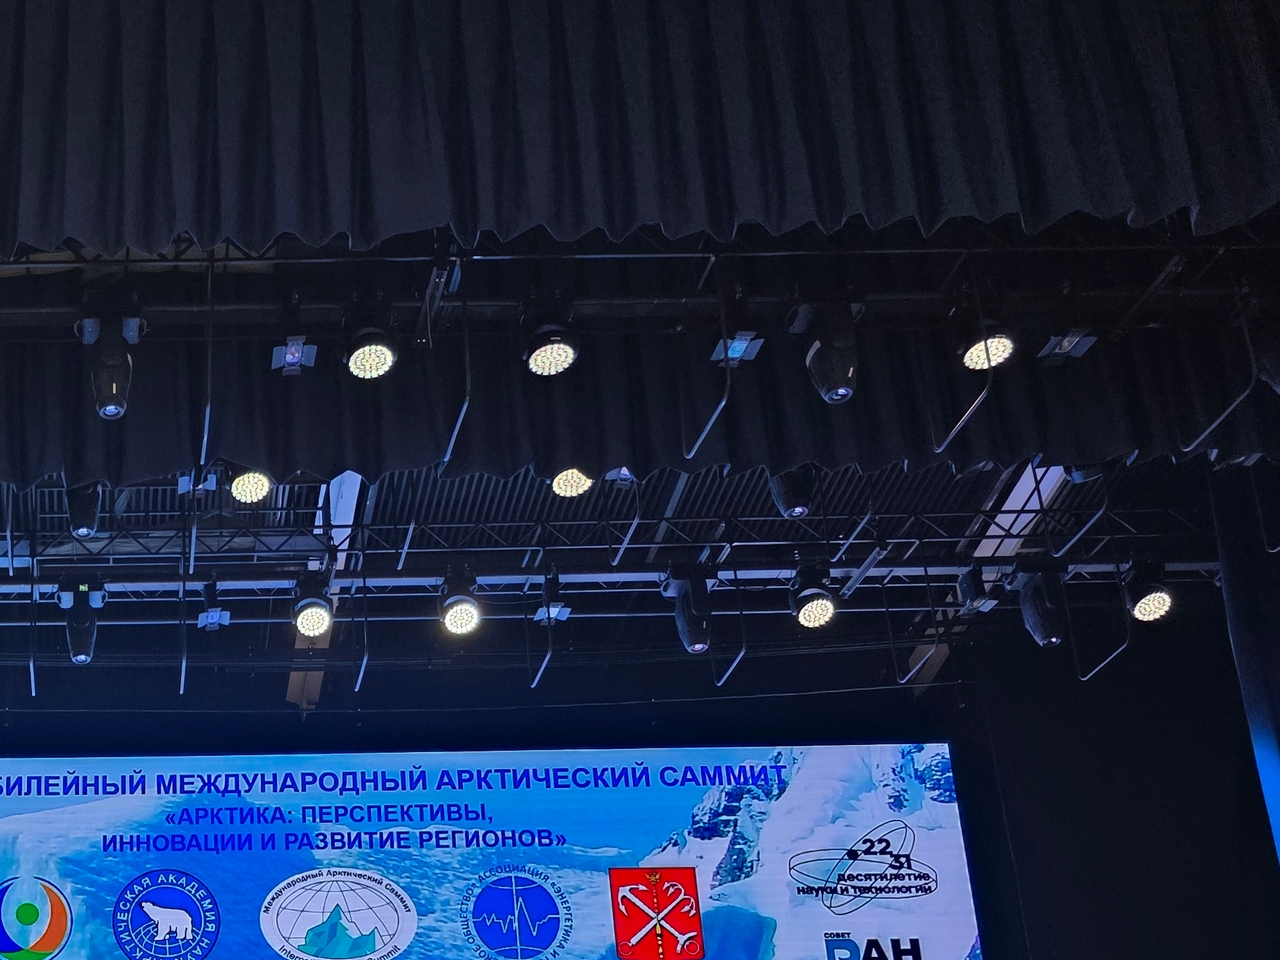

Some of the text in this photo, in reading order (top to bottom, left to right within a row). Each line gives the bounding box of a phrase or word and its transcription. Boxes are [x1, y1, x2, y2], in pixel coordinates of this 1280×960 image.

[156, 765, 428, 797] МЕЖДУНАРОДНЫЙ
[435, 762, 652, 791] АРКТИЧЕСКИЙ
[658, 764, 788, 788] САММИТ
[165, 803, 494, 826] «АРКТИКА: ПЕРСПЕКТИВЫ,
[102, 829, 567, 854] ИННОВАЦИИ И РАЗВИТИЕ РЕГИОНОВ»
[157, 873, 217, 933] АКАДЕМИЯ
[263, 869, 412, 915] Международный Арктический Саммит
[796, 885, 839, 898] науки
[852, 885, 933, 896] технологии
[477, 863, 550, 884] АССОЦИАЦИЯ
[550, 949, 560, 960] И
